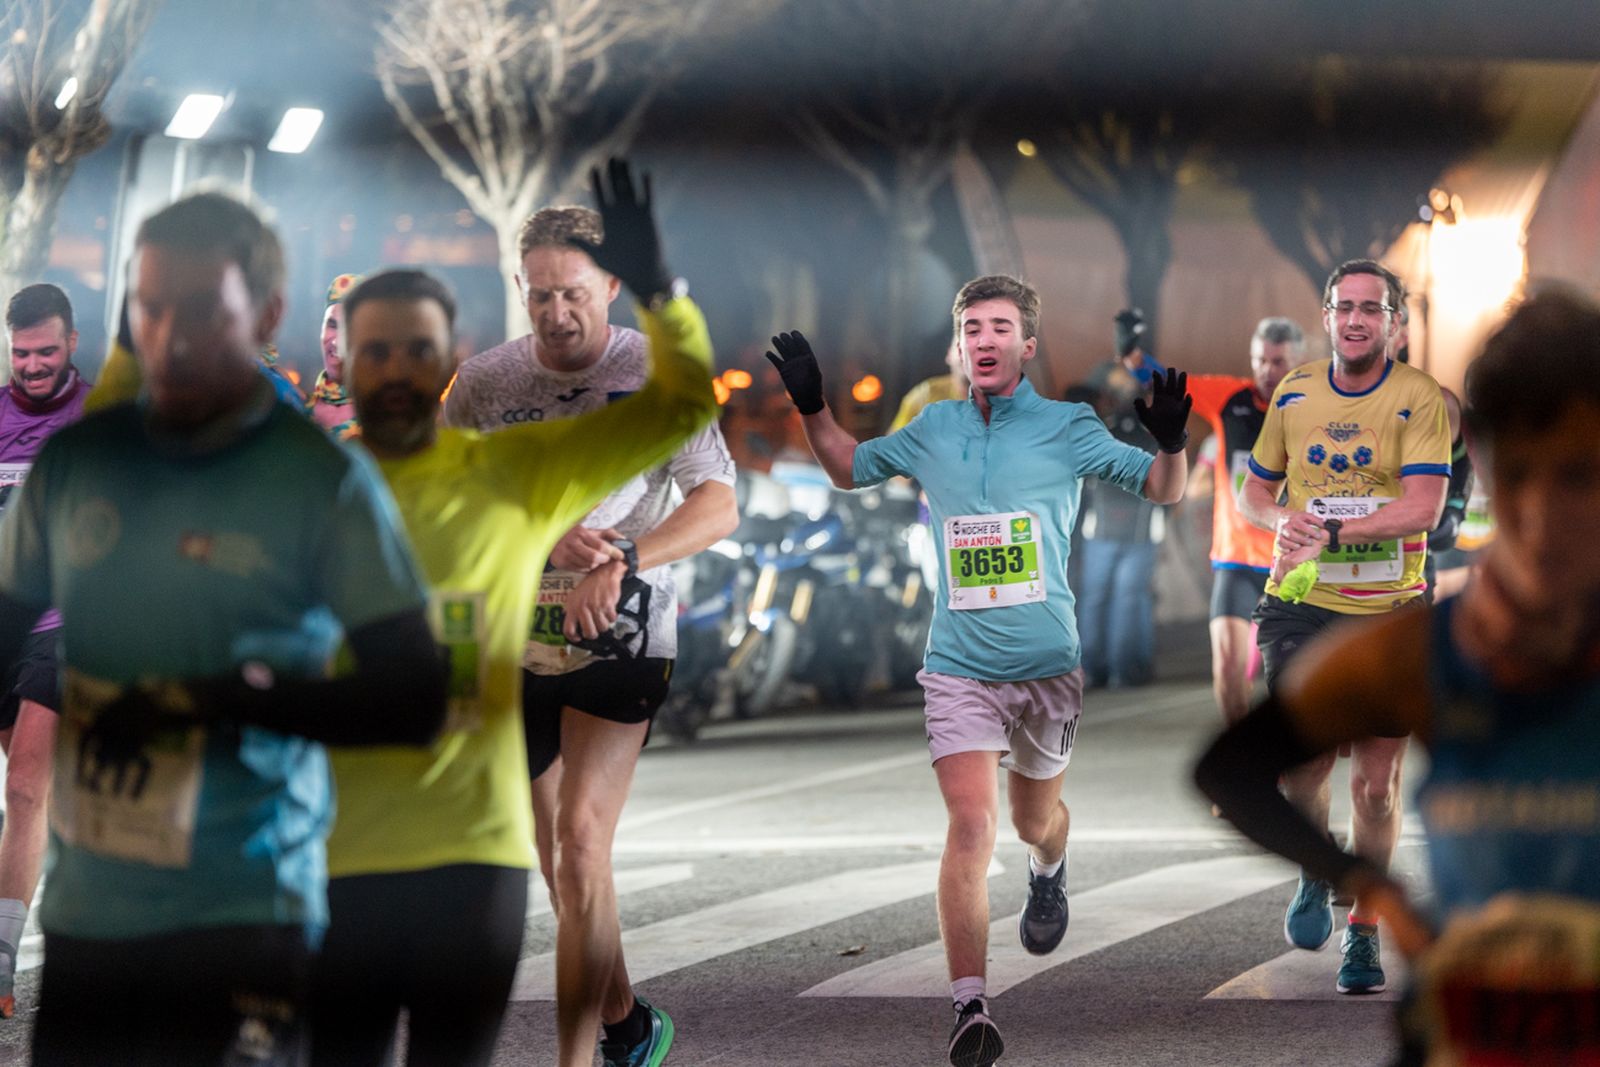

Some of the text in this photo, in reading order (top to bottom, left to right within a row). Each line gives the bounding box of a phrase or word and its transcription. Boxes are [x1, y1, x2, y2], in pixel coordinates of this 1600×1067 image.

[1327, 421, 1359, 430] CLUB
[1328, 506, 1369, 516] NOCHE DE
[961, 525, 988, 536] NOCHE
[989, 524, 1001, 534] DE
[954, 537, 969, 548] SAN
[960, 546, 1024, 578] 3653
